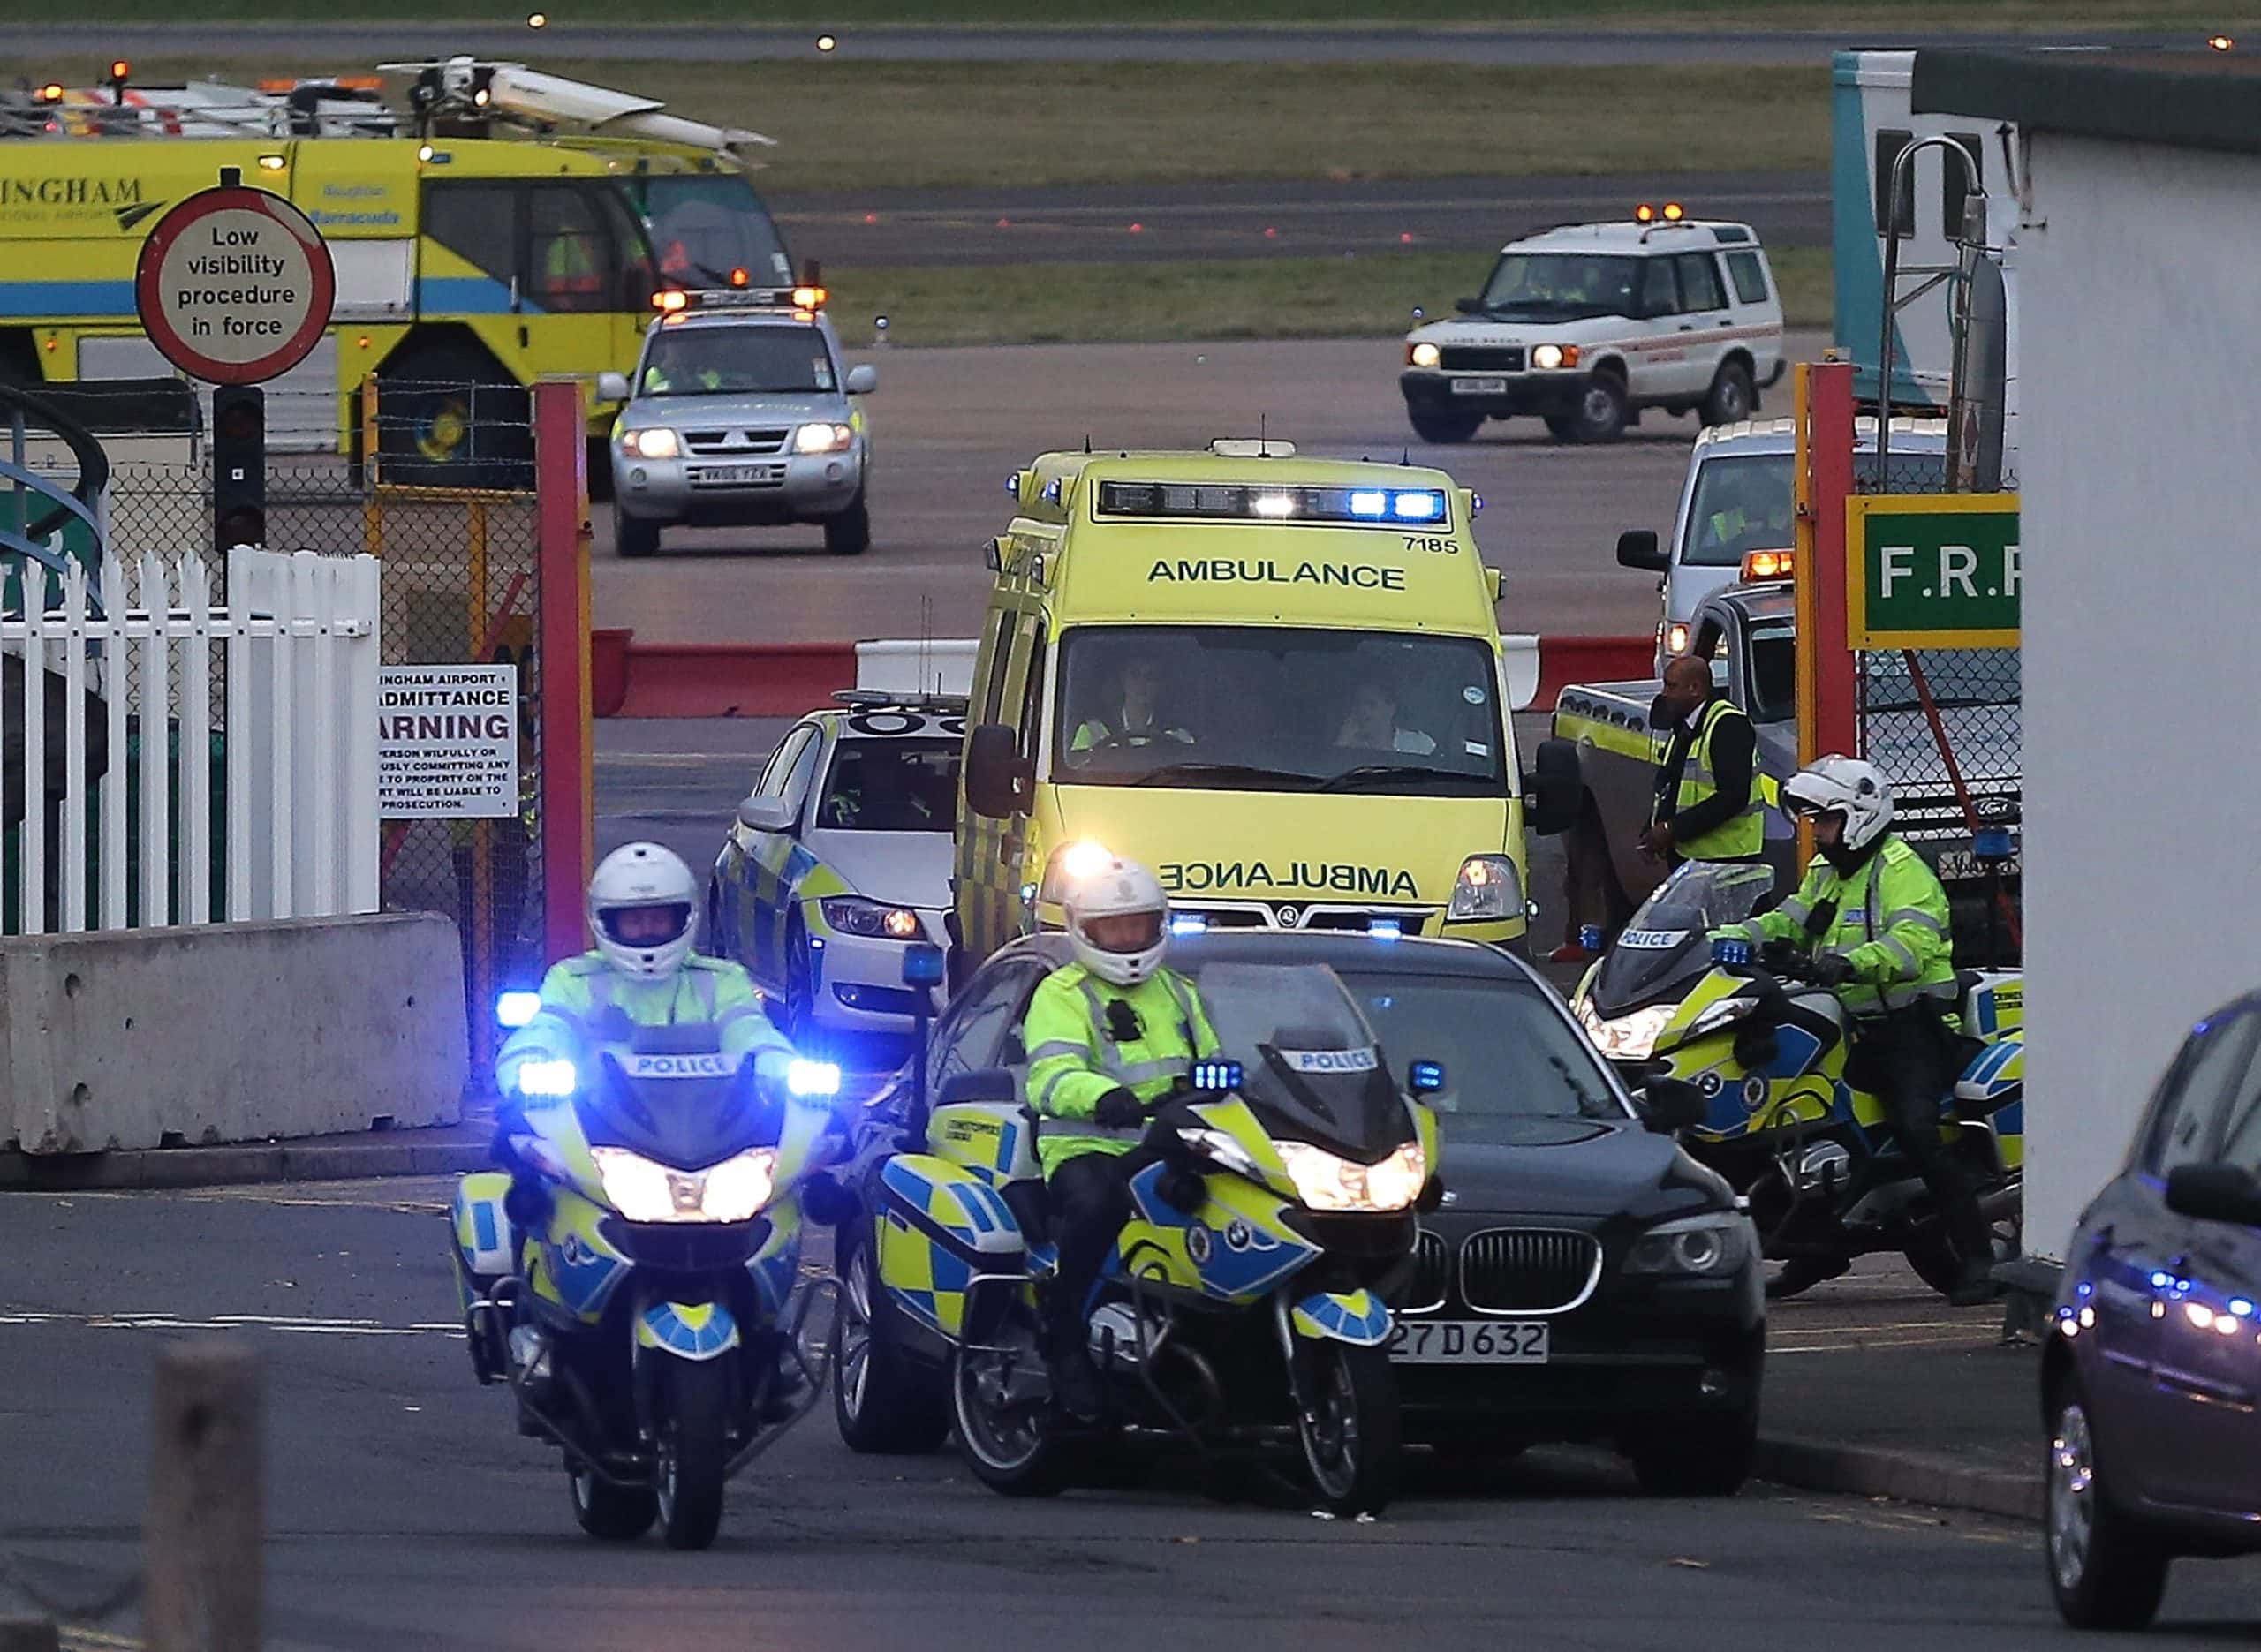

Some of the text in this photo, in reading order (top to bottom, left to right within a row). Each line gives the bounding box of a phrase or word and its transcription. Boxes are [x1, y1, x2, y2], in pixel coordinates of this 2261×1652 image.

[212, 227, 258, 245] Low
[188, 255, 284, 277] visibility
[178, 285, 295, 309] procedure
[193, 316, 283, 336] in force
[1402, 536, 1459, 554] 7185
[1147, 560, 1406, 591] AMBULANCE
[379, 674, 496, 685] INGHAM AIRPORT
[379, 690, 510, 706] DMITTANCE
[379, 748, 496, 758] ERSON WILFULLY OR
[413, 761, 484, 770] COMMITTING
[487, 761, 510, 770] ANY
[405, 774, 464, 783] PROPERTY
[466, 773, 483, 782] ON
[487, 773, 508, 781] THE
[397, 788, 423, 796] WILL
[444, 787, 481, 796] LIABLE
[486, 785, 501, 795] TO
[1622, 931, 1672, 946] POLICE
[638, 1057, 725, 1073] POLICE
[1302, 1052, 1374, 1069] POLICE
